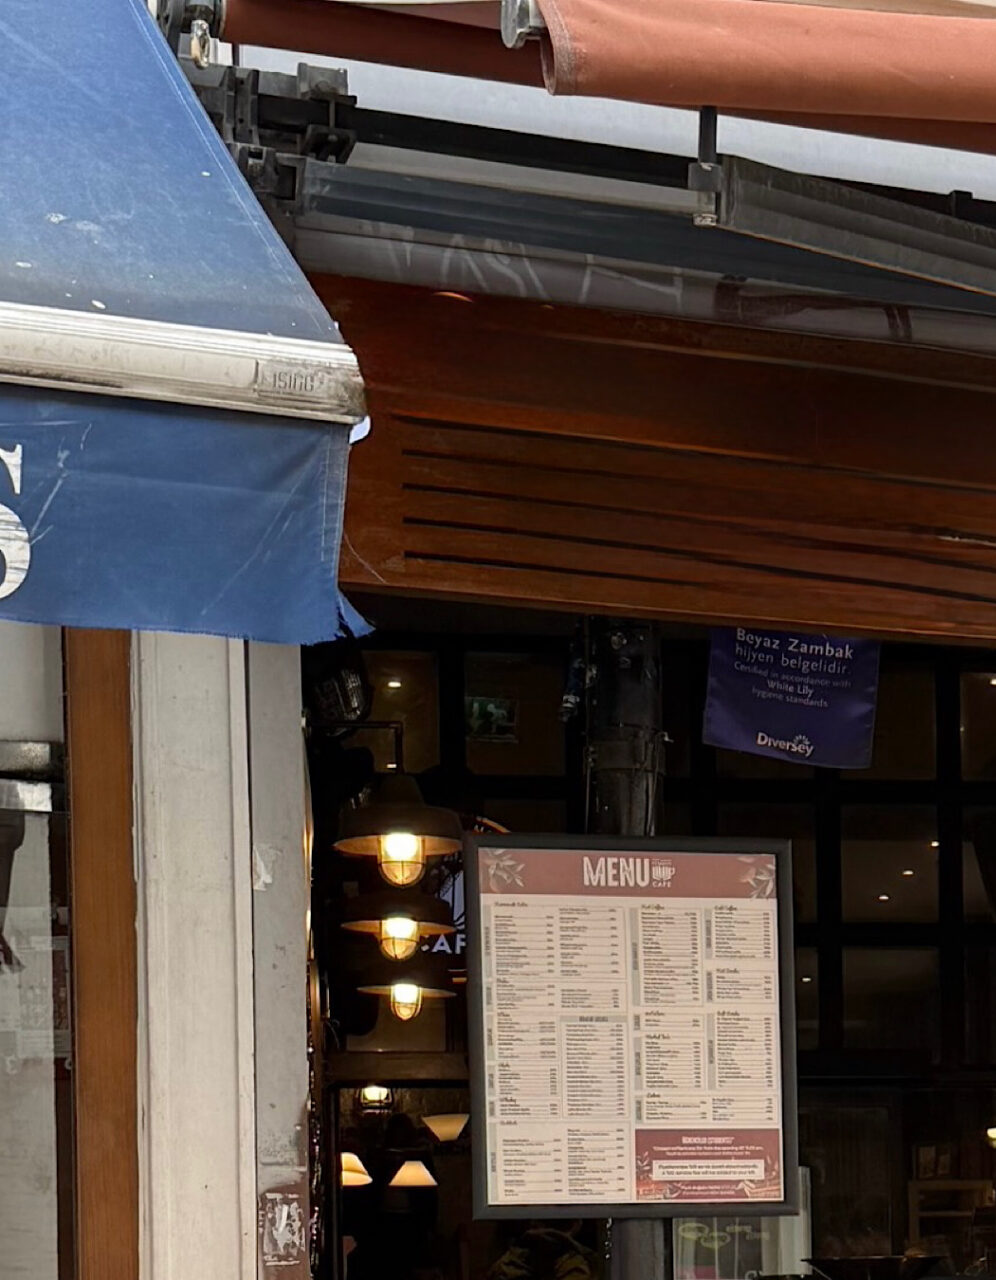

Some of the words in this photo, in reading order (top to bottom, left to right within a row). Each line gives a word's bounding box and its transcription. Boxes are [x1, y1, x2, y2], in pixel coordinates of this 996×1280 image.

[735, 642, 775, 664] hijyen
[736, 627, 781, 650] Beyaz
[787, 637, 854, 660] Zambak
[767, 679, 795, 694] White
[797, 684, 815, 699] Lily
[757, 731, 815, 758] Diversey
[583, 856, 651, 887] MENU
